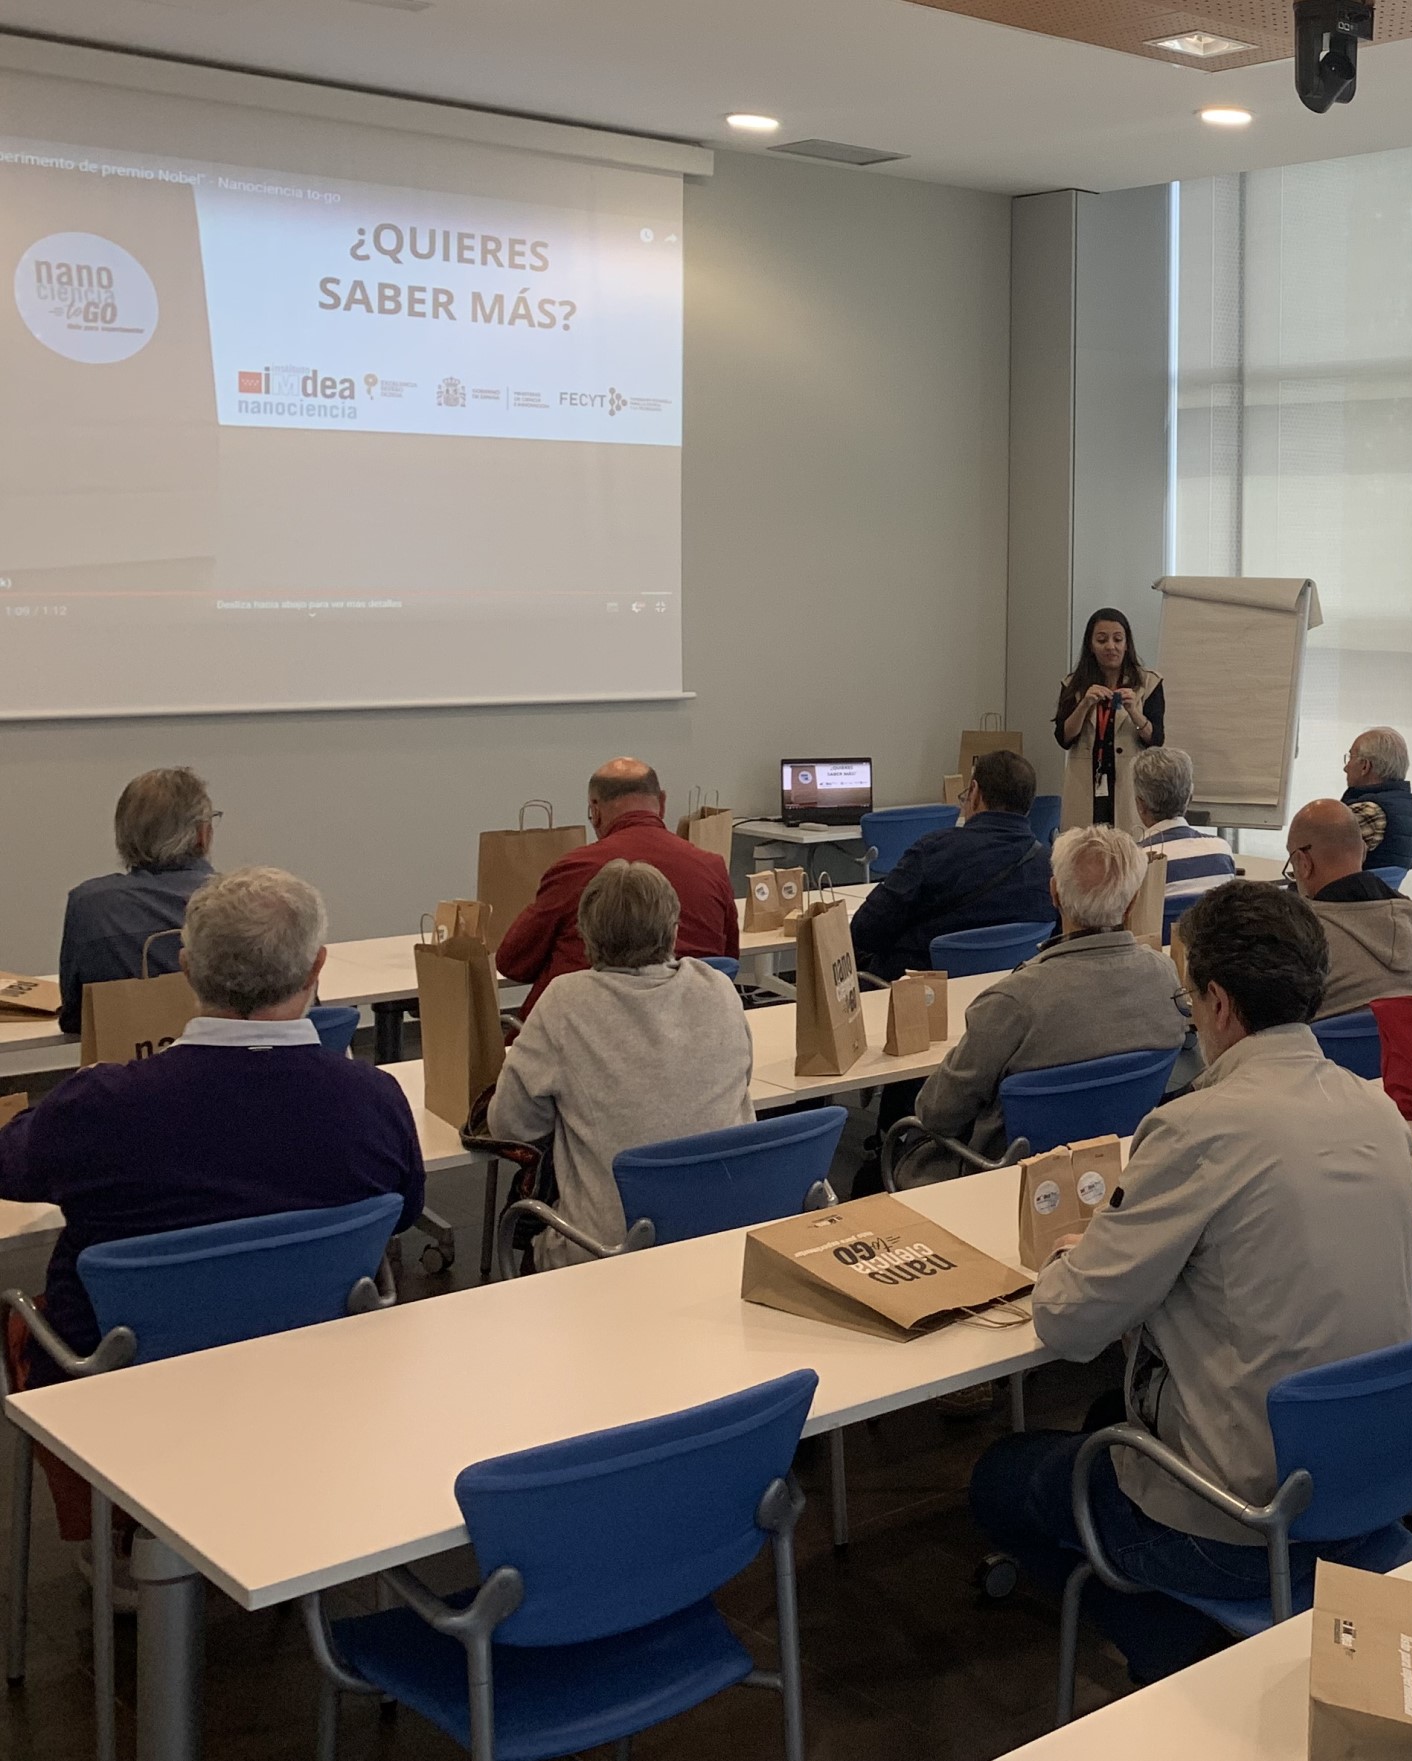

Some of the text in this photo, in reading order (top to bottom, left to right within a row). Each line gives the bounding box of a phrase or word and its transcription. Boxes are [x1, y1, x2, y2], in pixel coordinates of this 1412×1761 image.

[78, 158, 98, 173] de
[101, 164, 155, 181] premio
[217, 176, 304, 199] Nanociencia
[349, 221, 550, 273] ¿QUIERES
[35, 259, 114, 290] nano
[82, 300, 118, 325] GO
[317, 276, 578, 332] SABER MÁS?
[237, 397, 358, 420] nanociencia
[559, 391, 607, 408] FECYT
[216, 599, 252, 609] Desliza
[832, 1240, 876, 1266] GO
[849, 1241, 934, 1275] ciencia
[868, 1253, 958, 1285] nano
